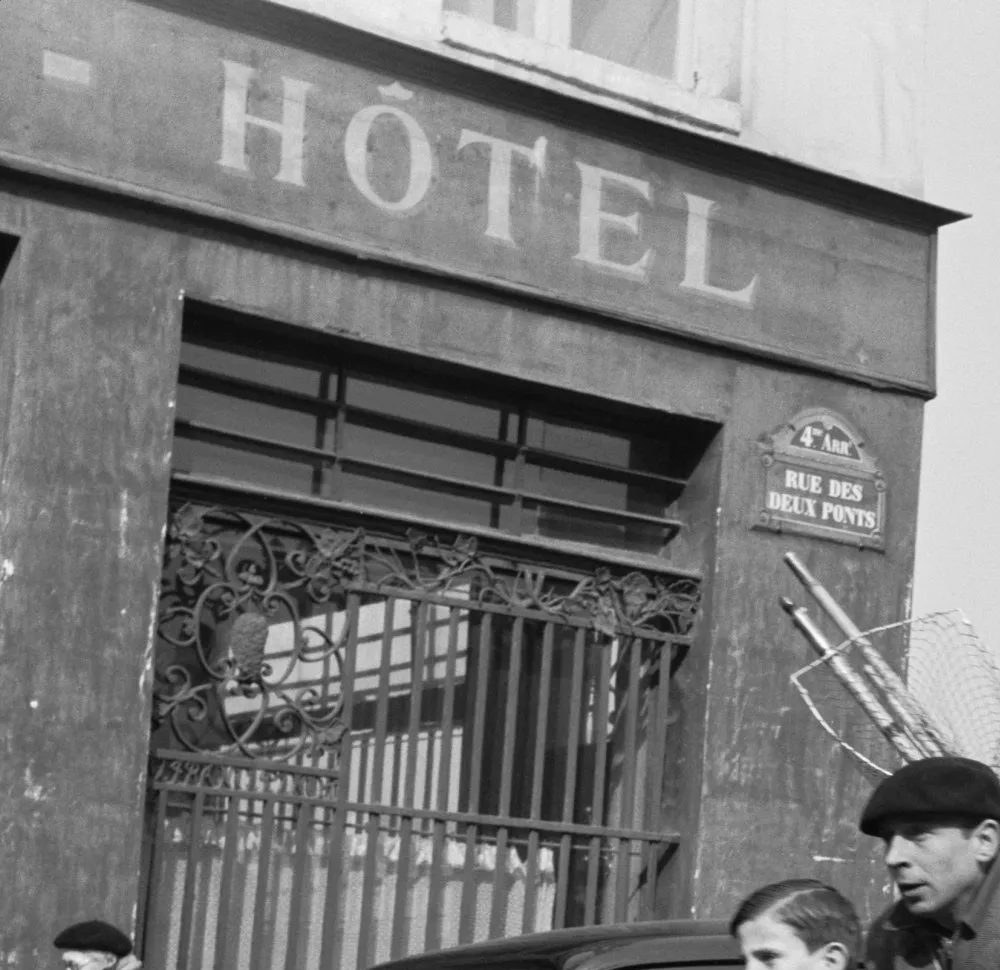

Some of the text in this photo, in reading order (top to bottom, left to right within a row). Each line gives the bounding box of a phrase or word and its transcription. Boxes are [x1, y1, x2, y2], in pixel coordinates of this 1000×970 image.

[215, 59, 760, 304] HÔTEL
[785, 469, 864, 502] RUE DES
[767, 491, 876, 529] DEUX PONTS
